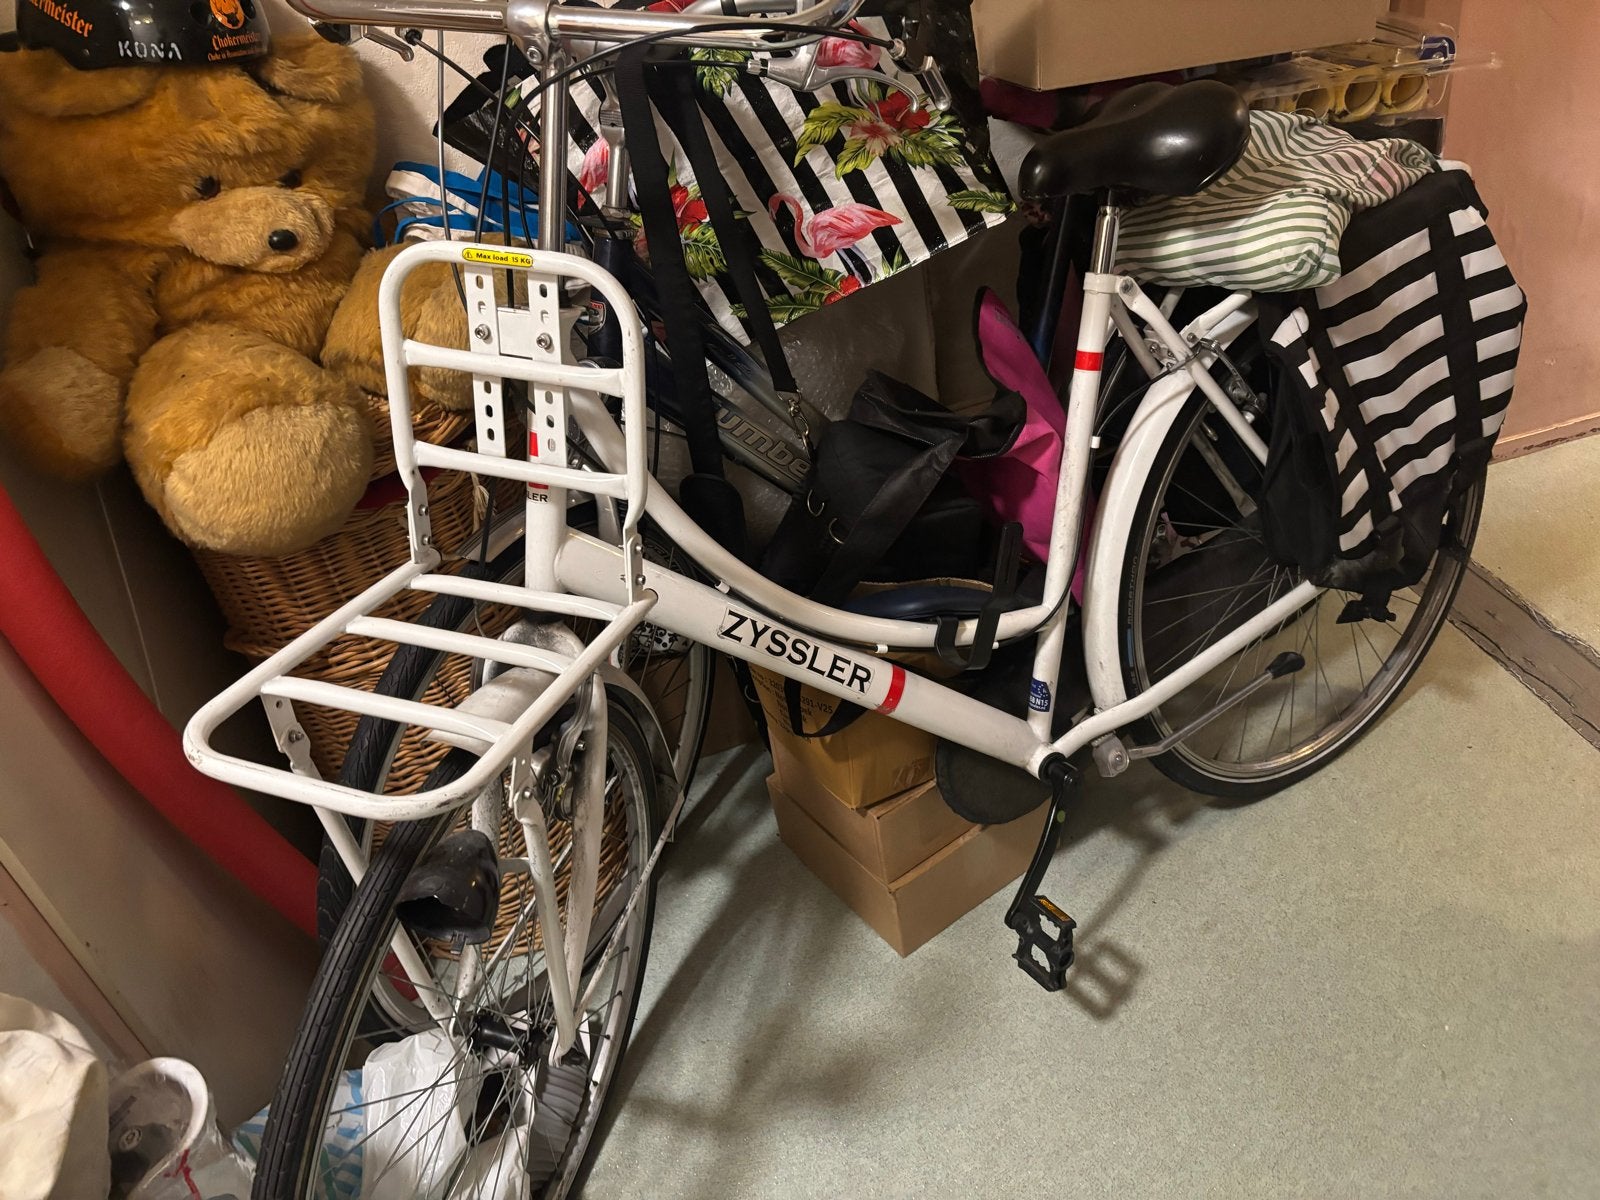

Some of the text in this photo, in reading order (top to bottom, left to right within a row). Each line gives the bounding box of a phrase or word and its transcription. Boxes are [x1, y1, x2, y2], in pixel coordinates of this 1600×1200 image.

[118, 40, 182, 60] KONA
[476, 252, 491, 260] Max
[492, 254, 509, 262] load
[721, 610, 872, 694] ZYSSLER
